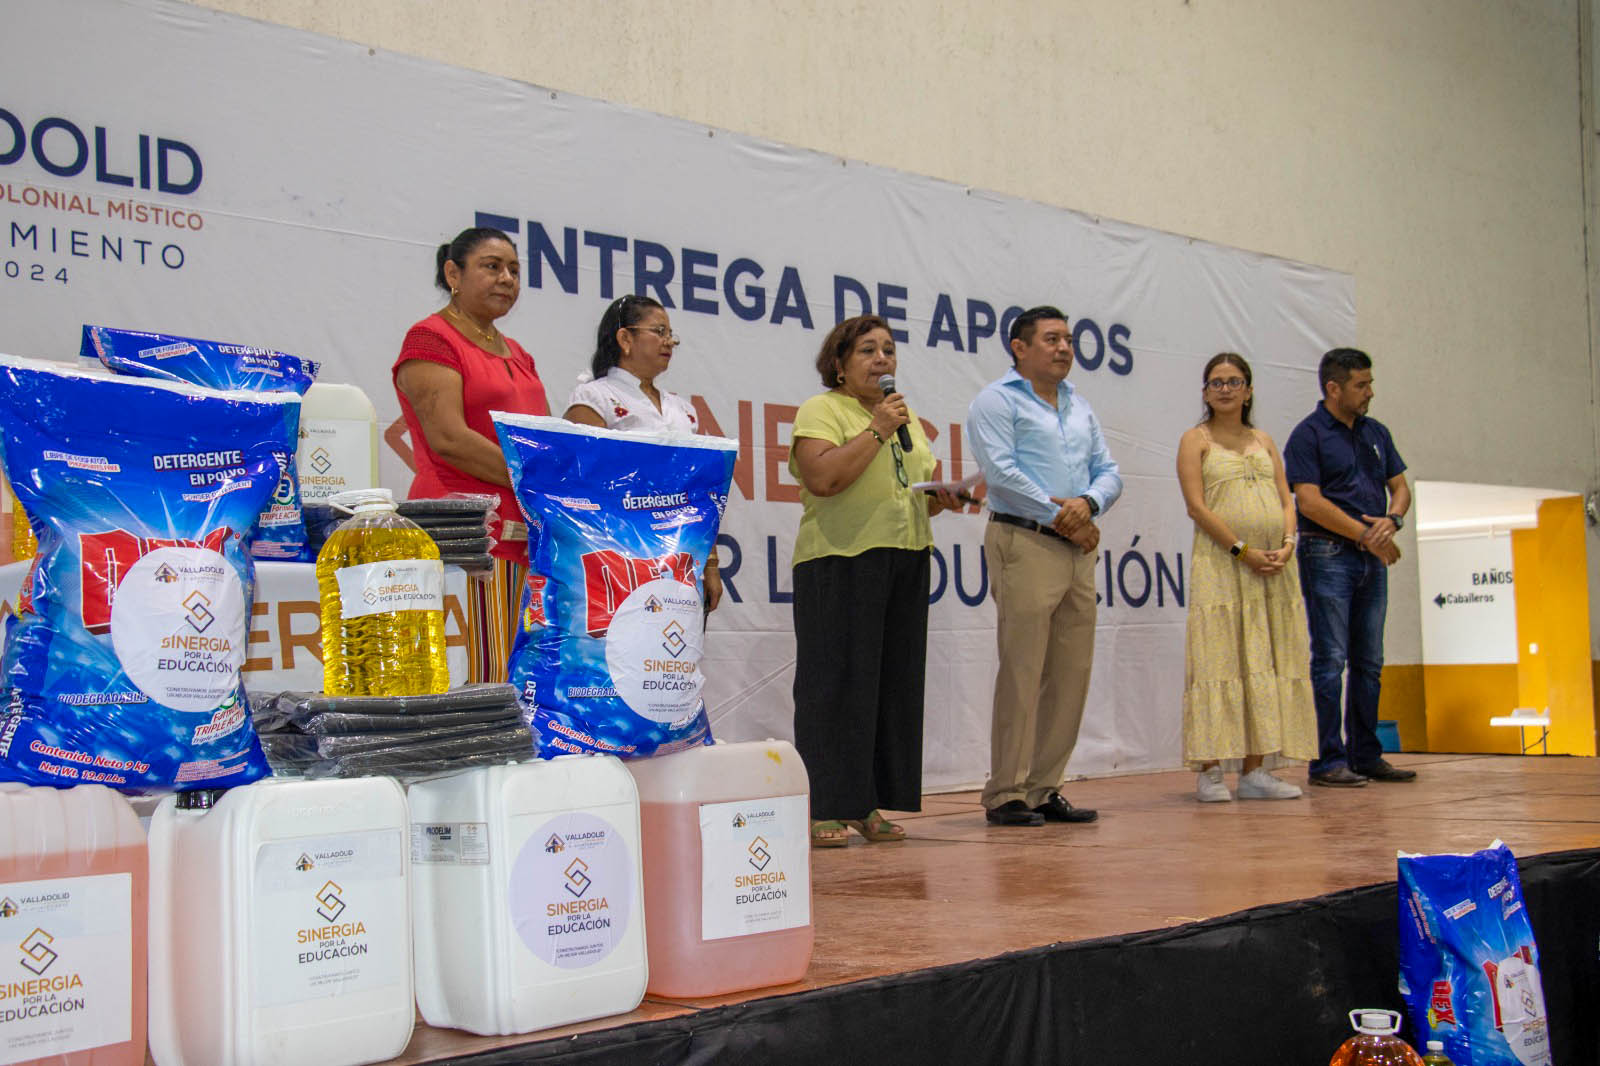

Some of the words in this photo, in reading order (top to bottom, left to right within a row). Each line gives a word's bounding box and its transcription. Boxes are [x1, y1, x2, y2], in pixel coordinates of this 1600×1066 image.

[0, 184, 100, 217] LONIAL
[107, 200, 204, 231] MÍSTICO
[11, 221, 185, 269] MIENTO
[5, 260, 69, 284] 024
[475, 211, 815, 331] NTREGA
[833, 274, 910, 344] DE
[926, 293, 1134, 377] APOOS
[153, 450, 242, 470] DETERGENTE
[190, 473, 206, 486] EN
[207, 467, 247, 485] POLVO
[622, 492, 688, 511] DETERGENTE
[651, 510, 665, 520] EN
[1472, 568, 1514, 586] BAÑOS
[379, 583, 419, 596] SINERGIA
[1446, 593, 1495, 605] Caballeros
[160, 634, 232, 653] SINERGIA
[184, 651, 202, 660] POR
[202, 652, 213, 660] LA
[157, 658, 233, 674] EDUCACIÓN
[662, 673, 676, 681] POR
[547, 720, 596, 746] Contenido
[30, 740, 93, 764] Contenido
[93, 755, 124, 770] Neto
[124, 760, 134, 771] 9
[134, 760, 150, 774] kg
[38, 761, 61, 775] Net
[565, 831, 605, 841] VALLADOLID
[315, 849, 354, 860] VALLADOLID
[735, 871, 787, 889] SINERGIA
[20, 891, 70, 905] VALLADOLID
[735, 889, 788, 905] EDUCACIÓN
[546, 896, 609, 917] SINERGIA
[567, 914, 581, 922] POR
[582, 912, 592, 920] LA
[297, 921, 367, 944] SINERGIA
[547, 917, 611, 936] EDUCACIÓN
[319, 939, 336, 949] POR
[336, 937, 347, 946] LA
[298, 943, 369, 964] EDUCACIÓN
[22, 994, 43, 1005] POR
[43, 992, 57, 1002] LA
